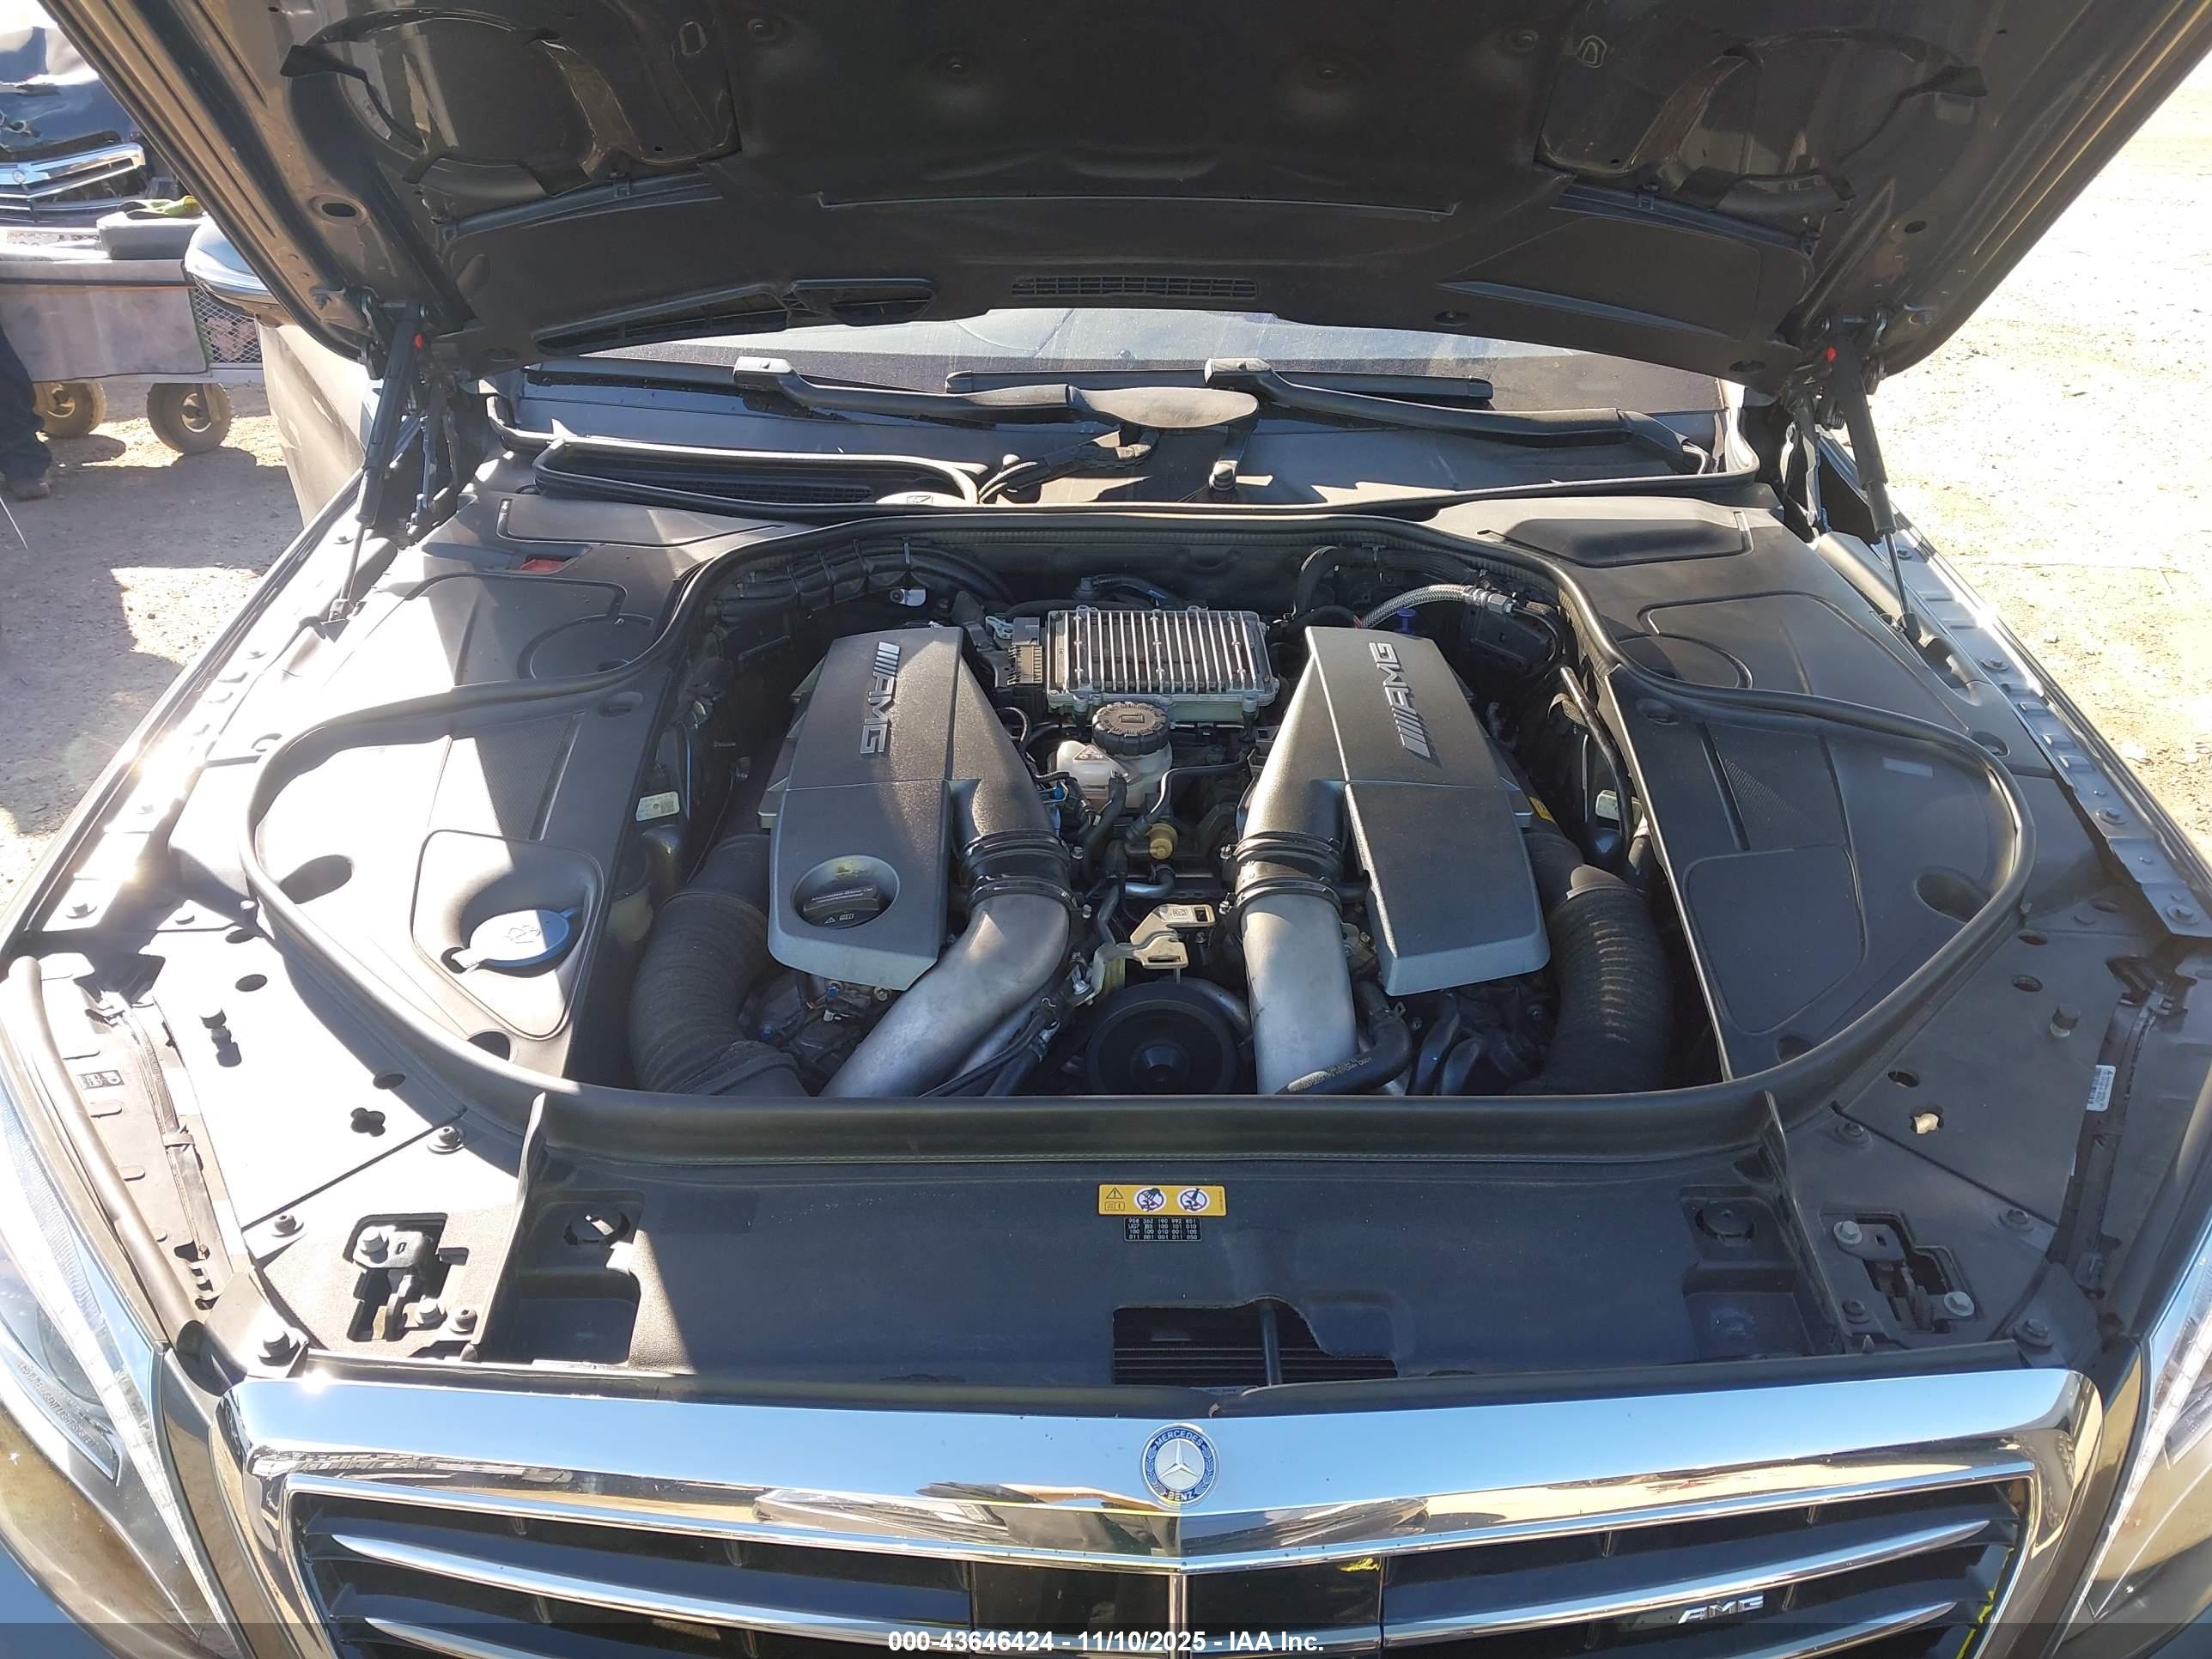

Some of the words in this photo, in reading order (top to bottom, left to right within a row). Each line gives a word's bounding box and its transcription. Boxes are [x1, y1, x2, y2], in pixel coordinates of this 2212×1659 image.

[860, 670, 896, 754] AMG
[1154, 1430, 1204, 1448] MERCEDES
[1167, 1491, 1194, 1501] BENZ
[1678, 1595, 1764, 1625] AMG
